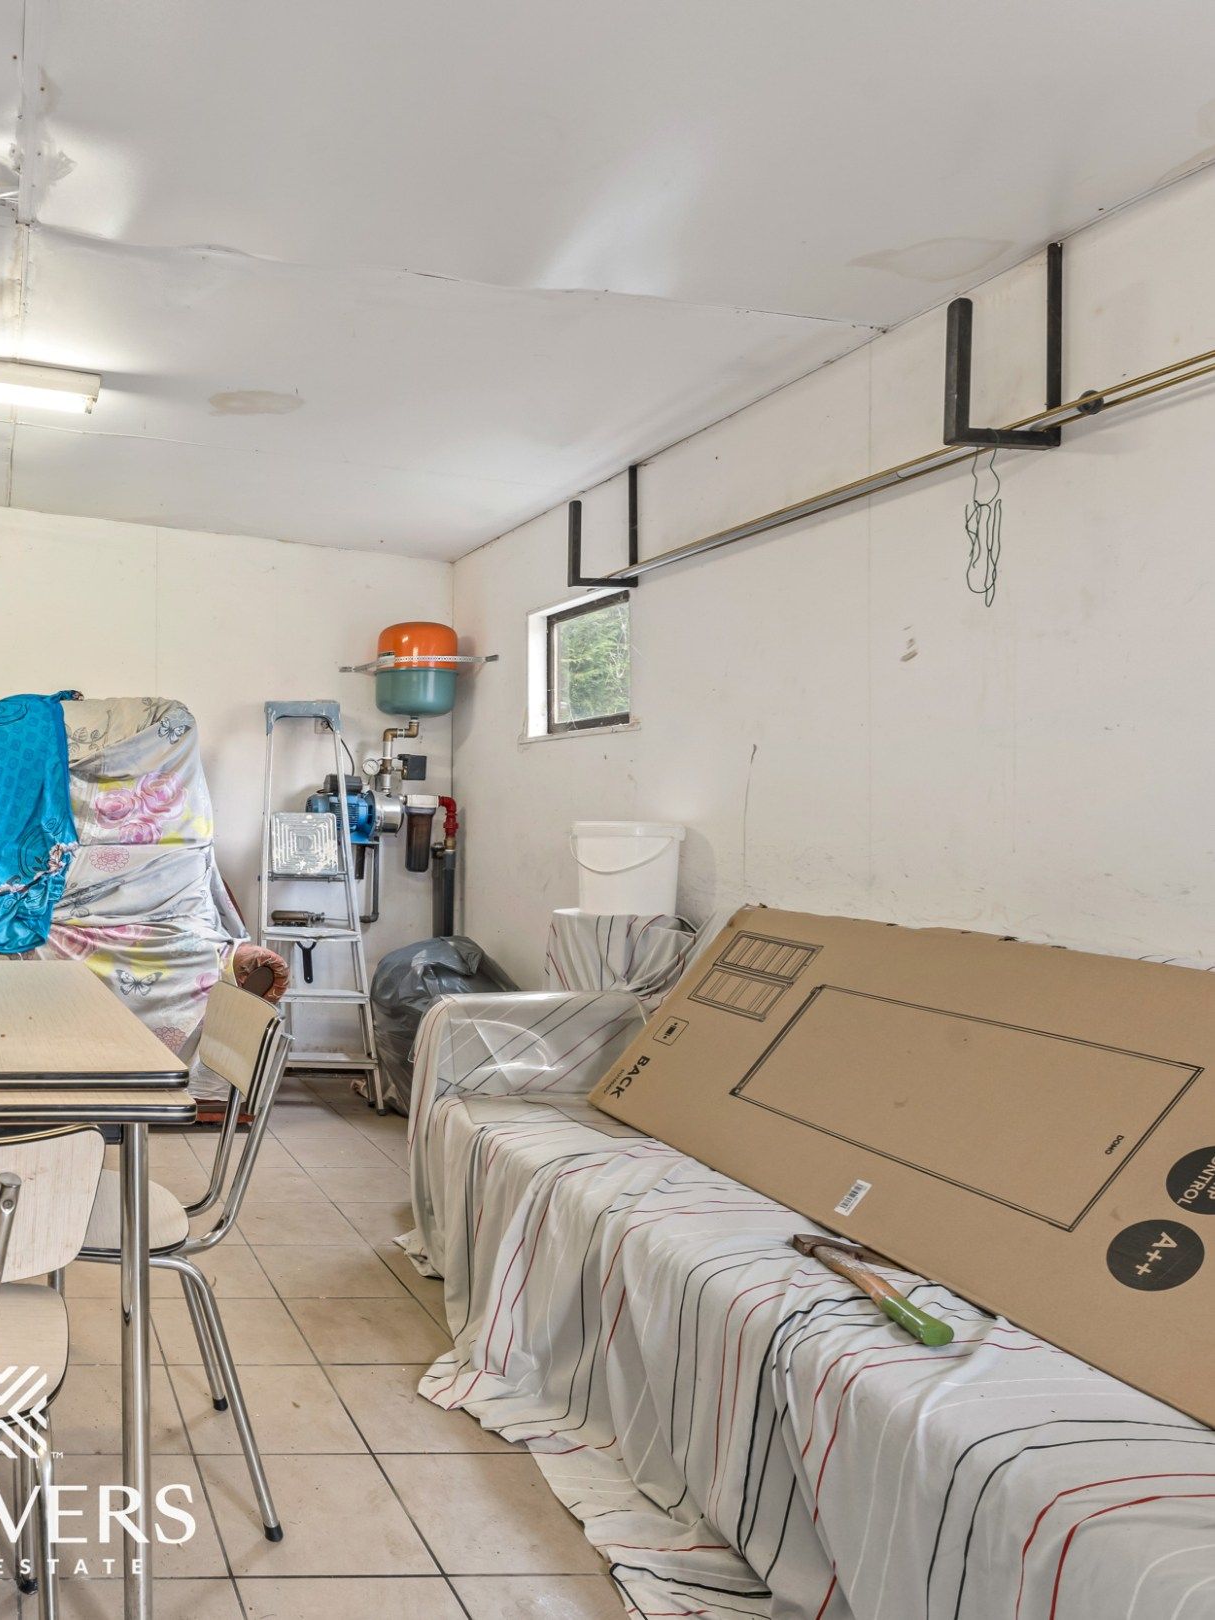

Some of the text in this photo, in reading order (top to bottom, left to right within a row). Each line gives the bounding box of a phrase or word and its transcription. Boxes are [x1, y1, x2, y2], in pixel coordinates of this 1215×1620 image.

[610, 1055, 651, 1099] BACK
[1104, 1134, 1125, 1156] DOMO
[1176, 1156, 1215, 1204] NTROL
[1135, 1231, 1178, 1276] A++
